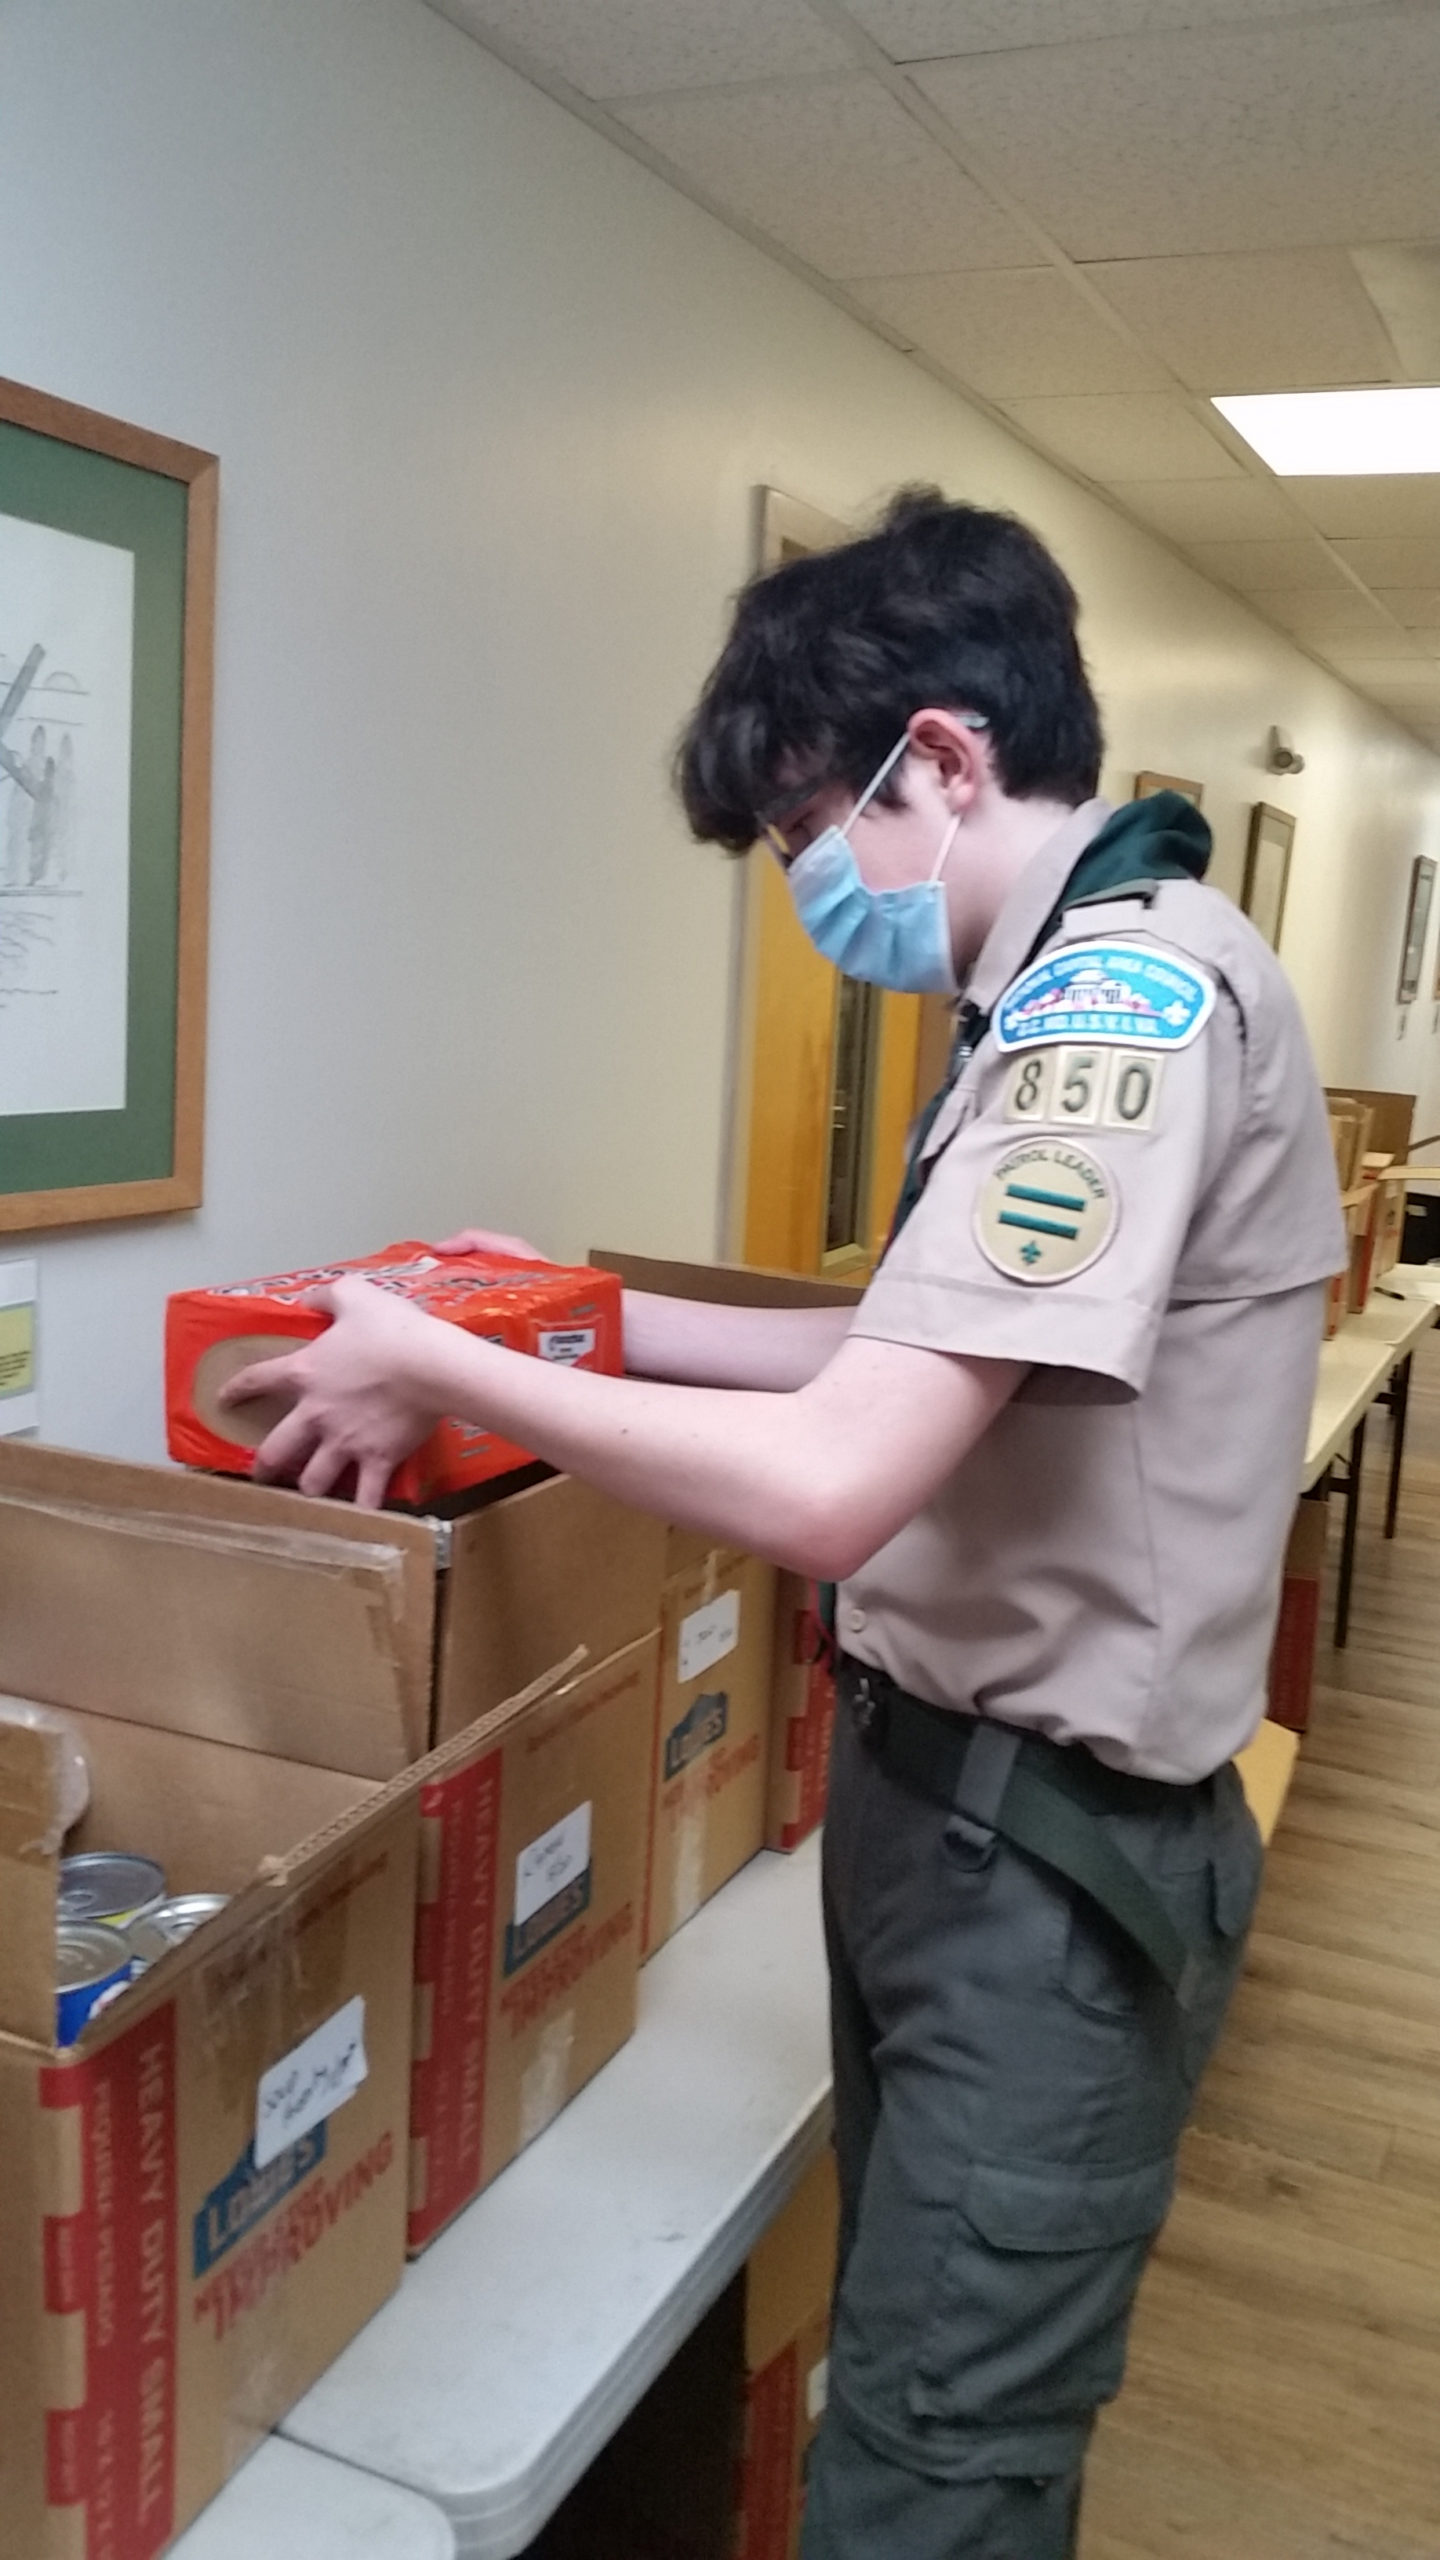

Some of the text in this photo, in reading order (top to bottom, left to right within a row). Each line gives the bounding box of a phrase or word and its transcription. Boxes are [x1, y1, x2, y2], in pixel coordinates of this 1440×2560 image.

[1015, 1057, 1151, 1120] 850
[994, 1149, 1105, 1198] PATROL LEADER
[138, 2043, 167, 2527] HEAVY DUTY SMALL
